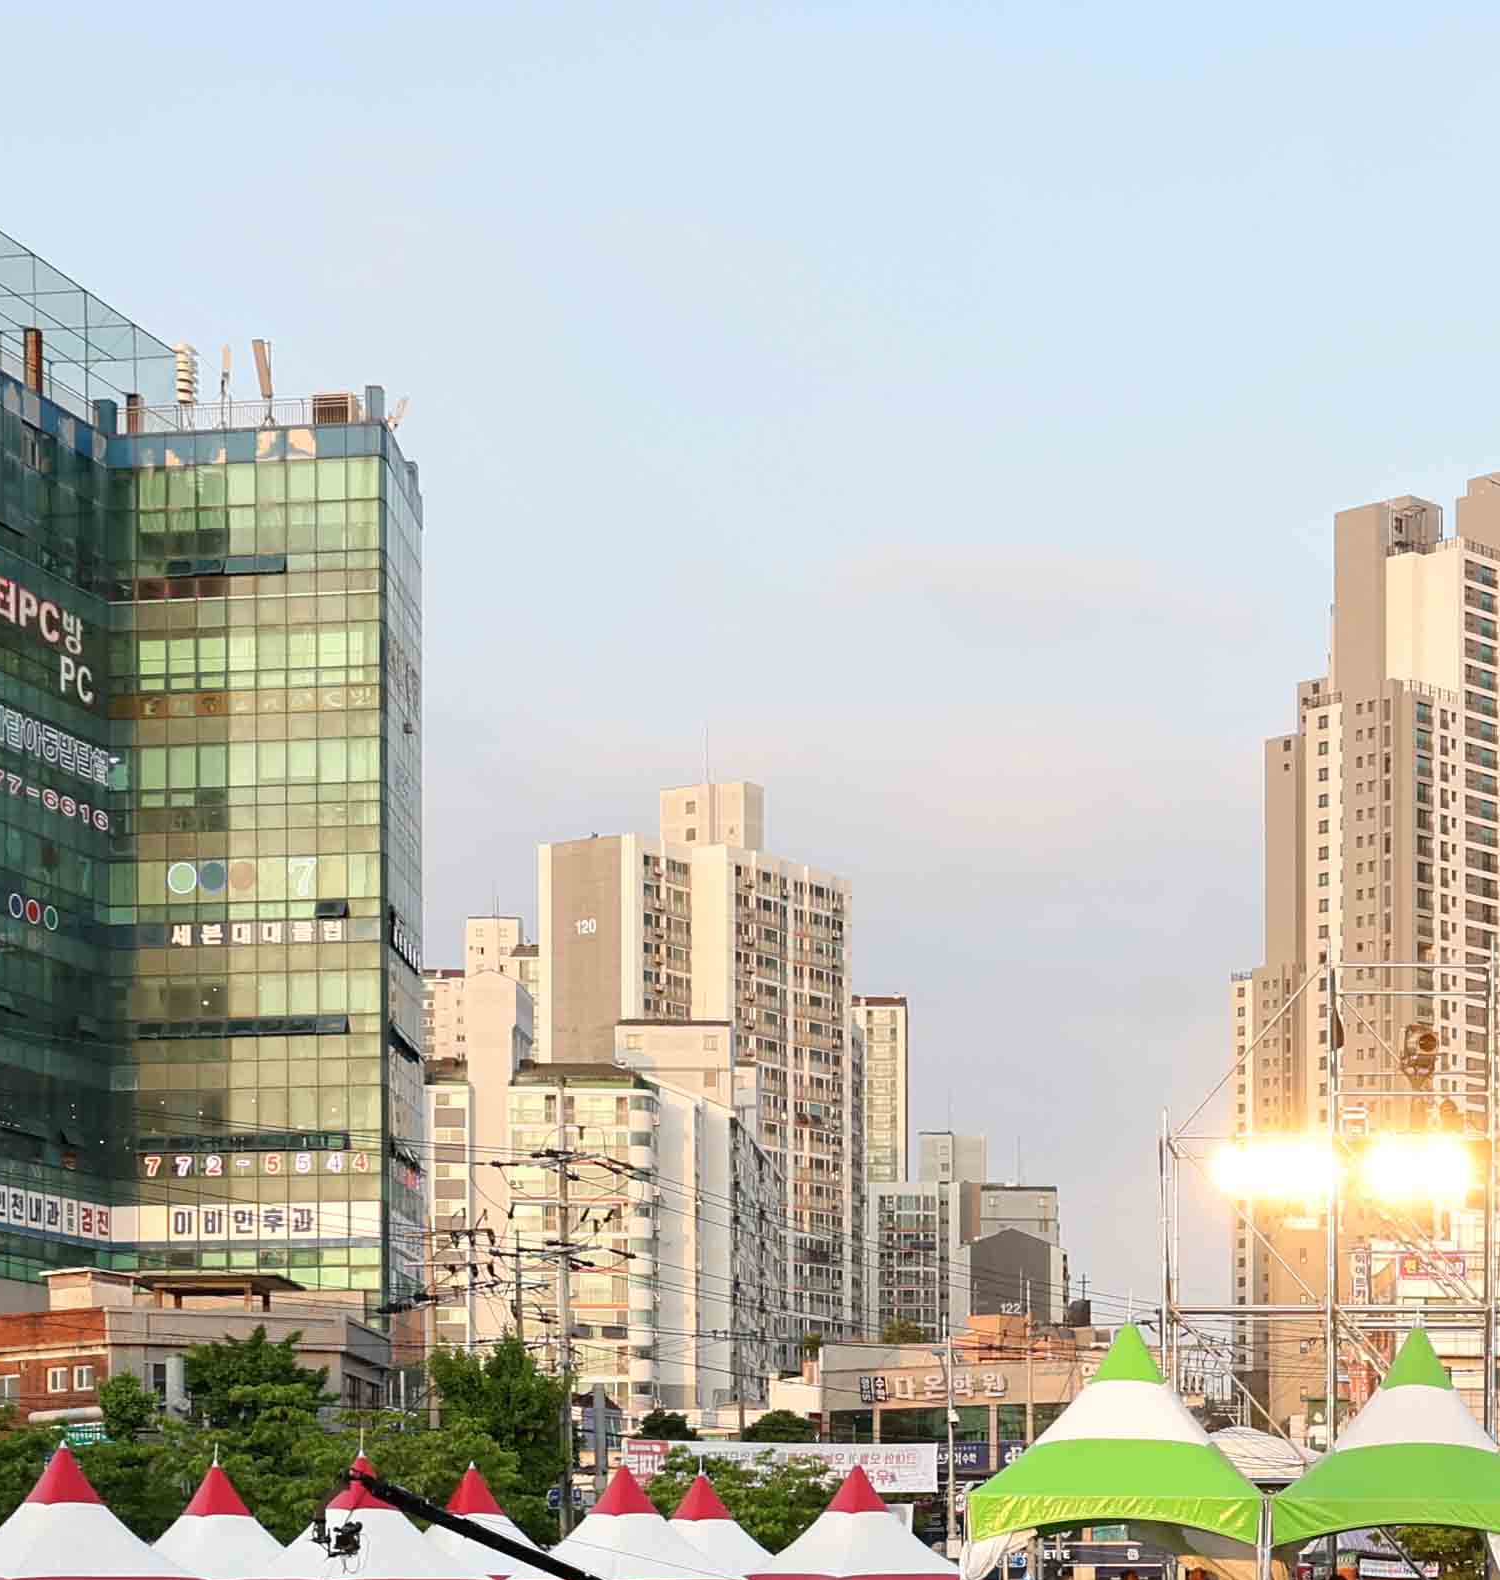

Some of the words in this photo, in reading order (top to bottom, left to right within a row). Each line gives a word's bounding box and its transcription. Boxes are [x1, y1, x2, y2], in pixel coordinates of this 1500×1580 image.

[60, 654, 94, 705] PC
[143, 1153, 370, 1177] 772-5544
[173, 1207, 315, 1235] 이비인후과
[1001, 1303, 1021, 1314] 122
